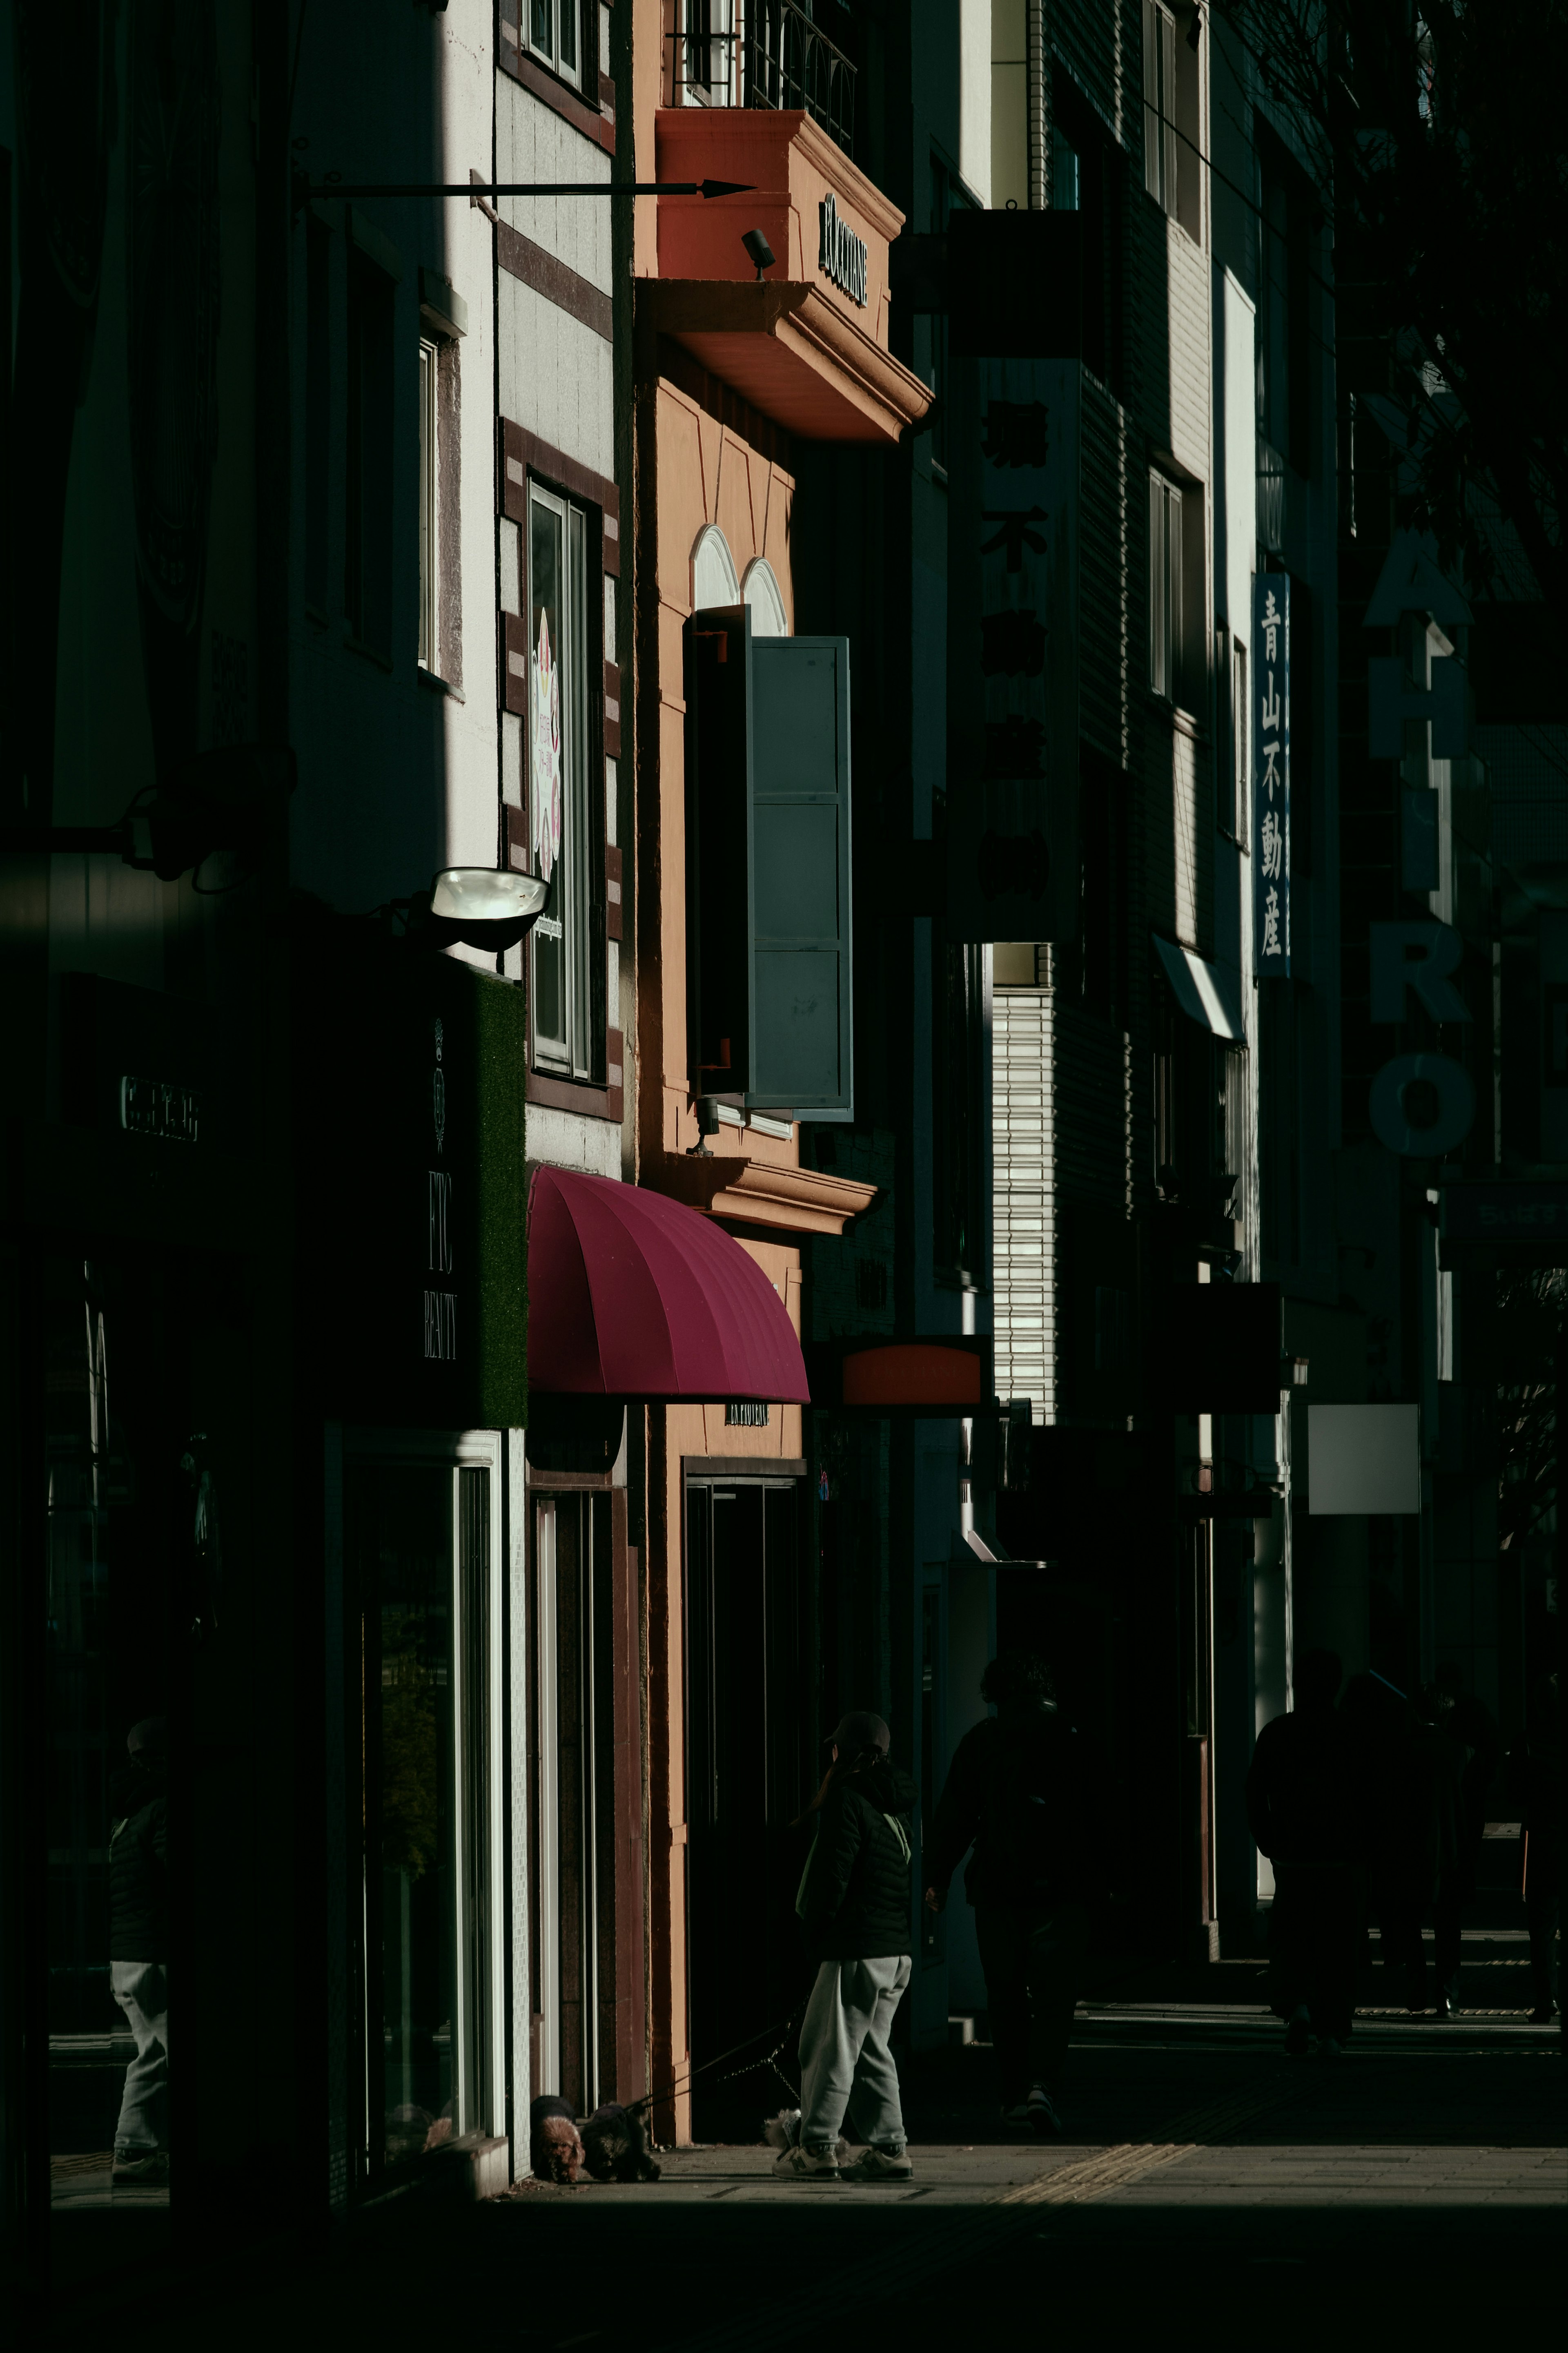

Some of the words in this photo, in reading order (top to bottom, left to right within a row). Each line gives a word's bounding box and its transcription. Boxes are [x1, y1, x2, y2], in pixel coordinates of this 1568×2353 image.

[822, 193, 868, 309] L'OCCITANE
[1261, 589, 1283, 957] 青山不動産
[428, 1171, 452, 1274] FTC
[424, 1291, 458, 1360] BEAUTY
